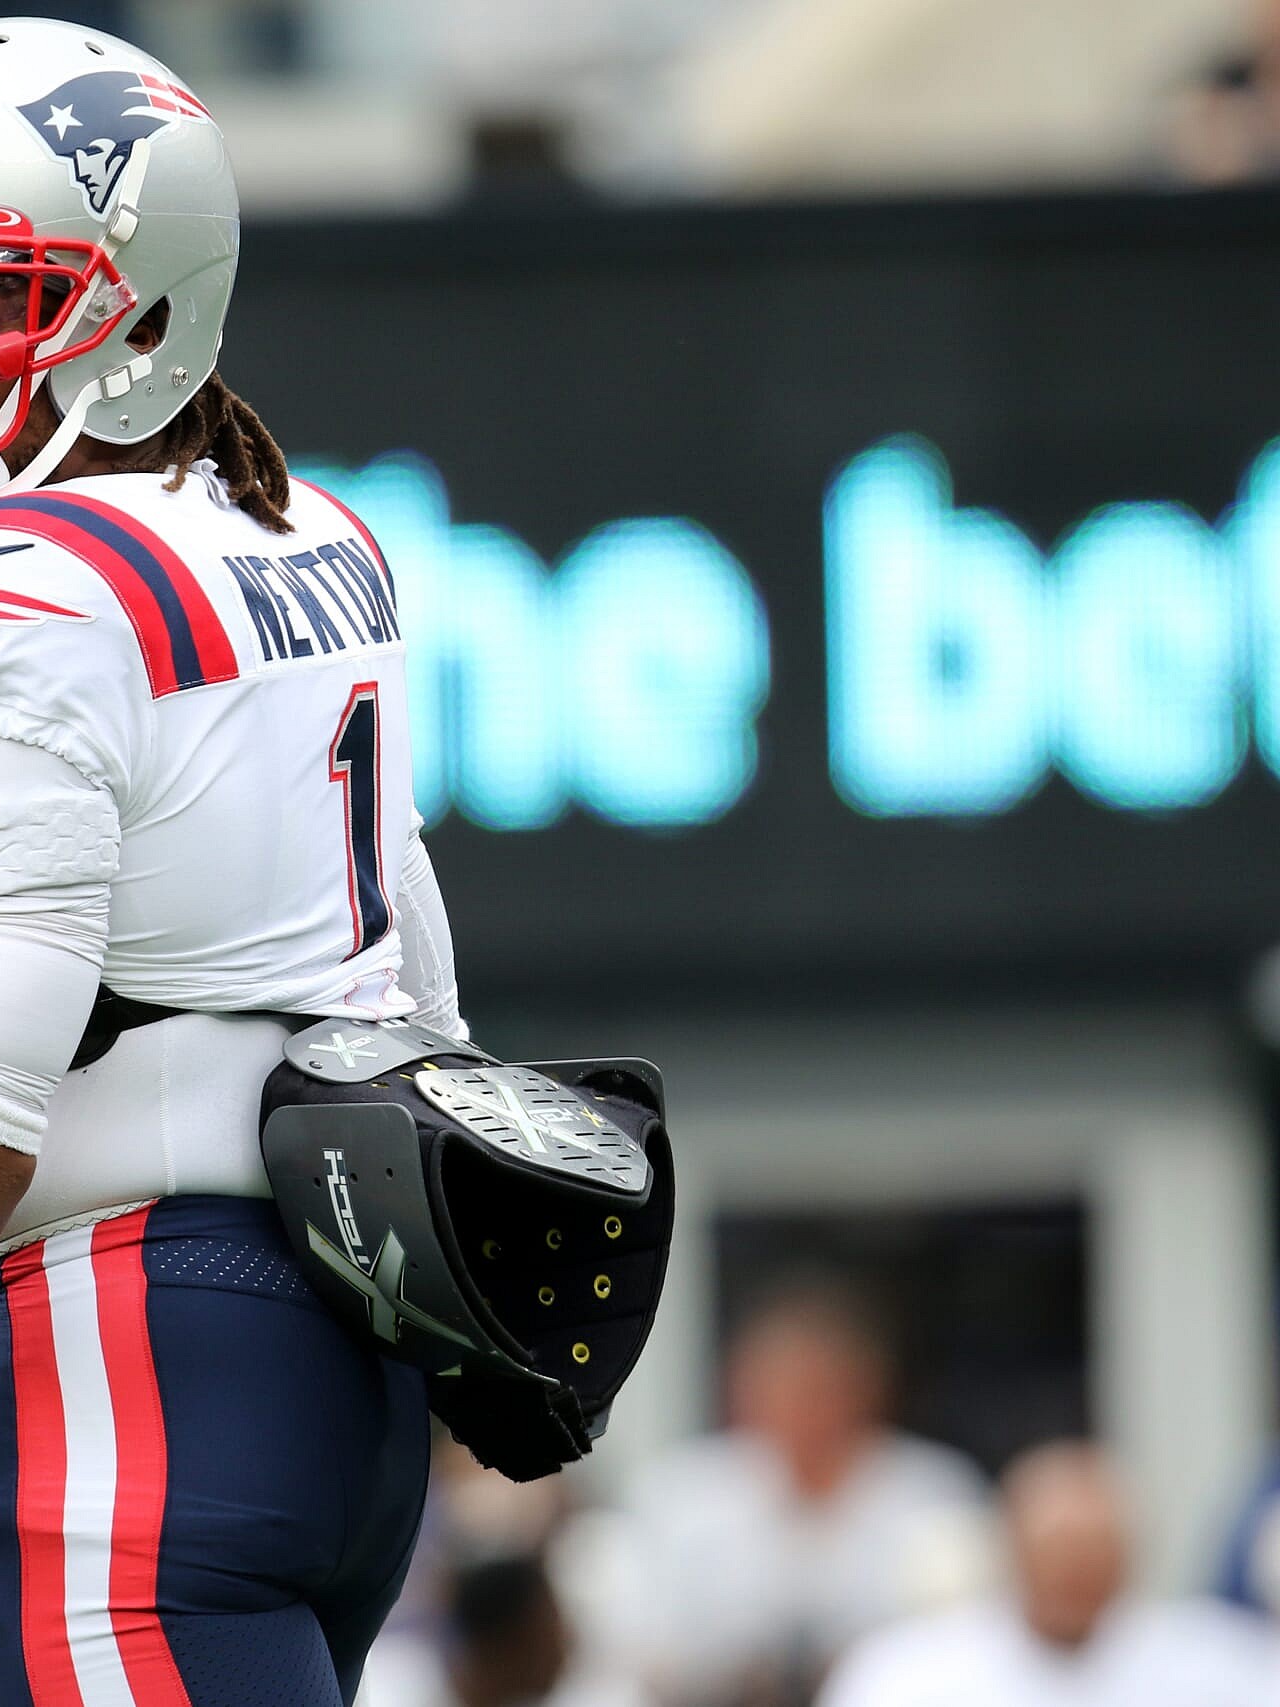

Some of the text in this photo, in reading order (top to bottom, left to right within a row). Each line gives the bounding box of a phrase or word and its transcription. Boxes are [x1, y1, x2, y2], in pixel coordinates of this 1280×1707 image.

[221, 537, 401, 662] NEWTON
[290, 432, 1280, 832] he be
[329, 681, 393, 962] 1
